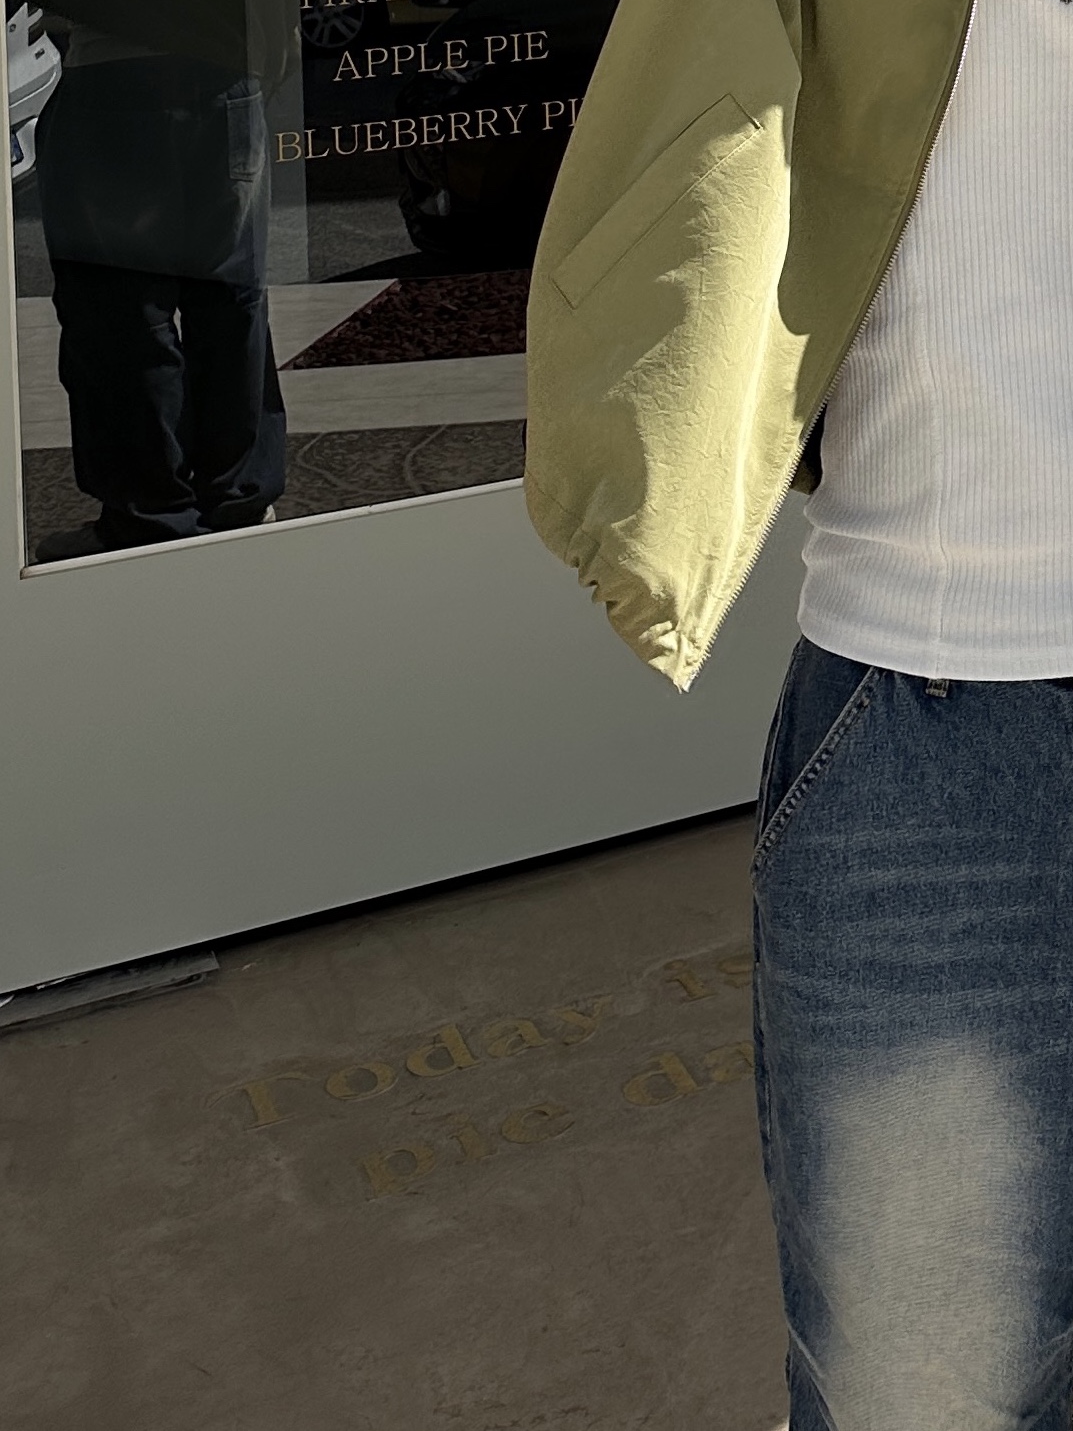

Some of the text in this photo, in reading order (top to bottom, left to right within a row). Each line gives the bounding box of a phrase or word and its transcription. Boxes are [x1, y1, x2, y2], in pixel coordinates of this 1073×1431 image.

[333, 30, 550, 82] APPLE PIE
[275, 97, 585, 164] BLUEBERRY PI
[207, 993, 613, 1131] Today
[622, 1039, 756, 1107] da
